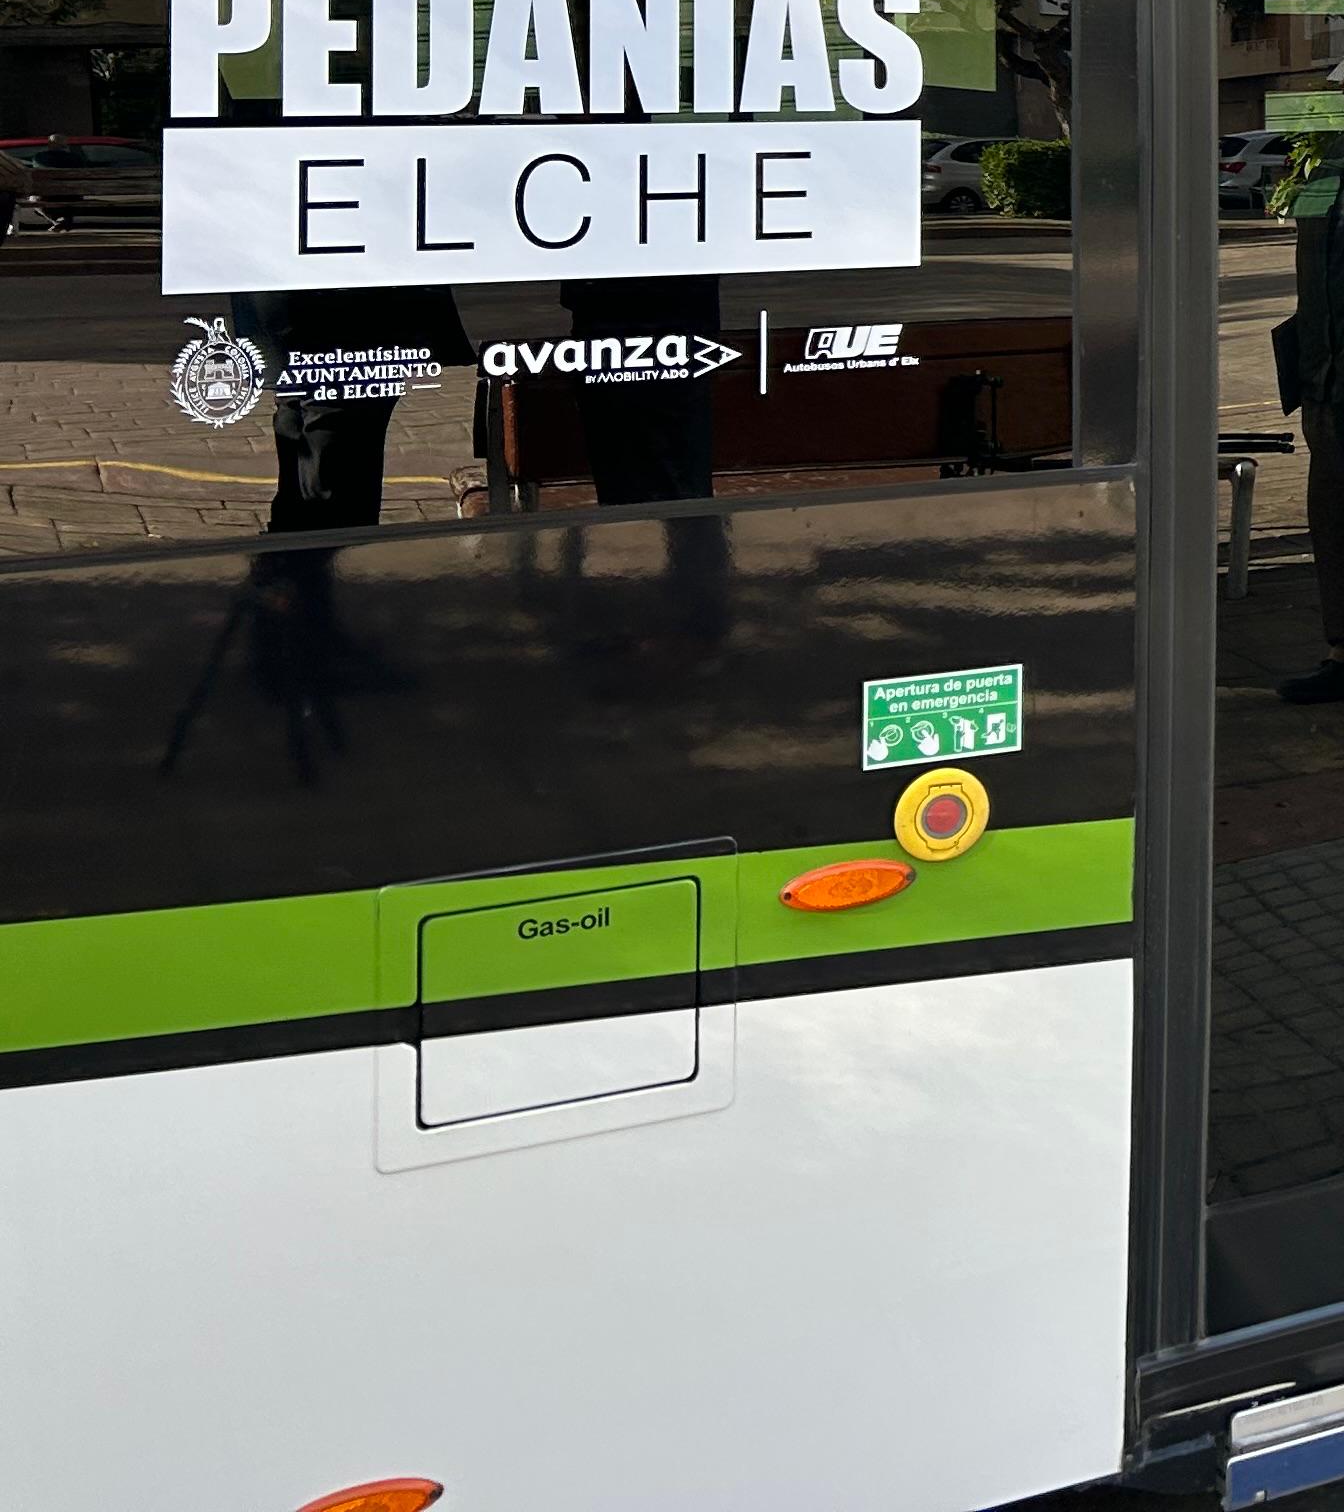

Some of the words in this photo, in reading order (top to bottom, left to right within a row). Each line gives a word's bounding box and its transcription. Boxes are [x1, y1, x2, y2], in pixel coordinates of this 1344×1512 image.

[297, 150, 813, 255] ELCHE
[288, 345, 431, 367] Excelentísimo
[483, 333, 690, 377] avanza
[276, 362, 443, 386] AYUNTAMIENTO
[597, 370, 660, 384] MOBILITY
[661, 368, 689, 380] ADO
[314, 385, 337, 401] de
[343, 381, 407, 400] ELCHE
[873, 683, 940, 702] Apertura
[943, 678, 962, 693] de
[966, 672, 1013, 692] puerta
[889, 700, 907, 713] en
[911, 689, 998, 711] emergencia
[517, 906, 610, 940] Gas-oil
